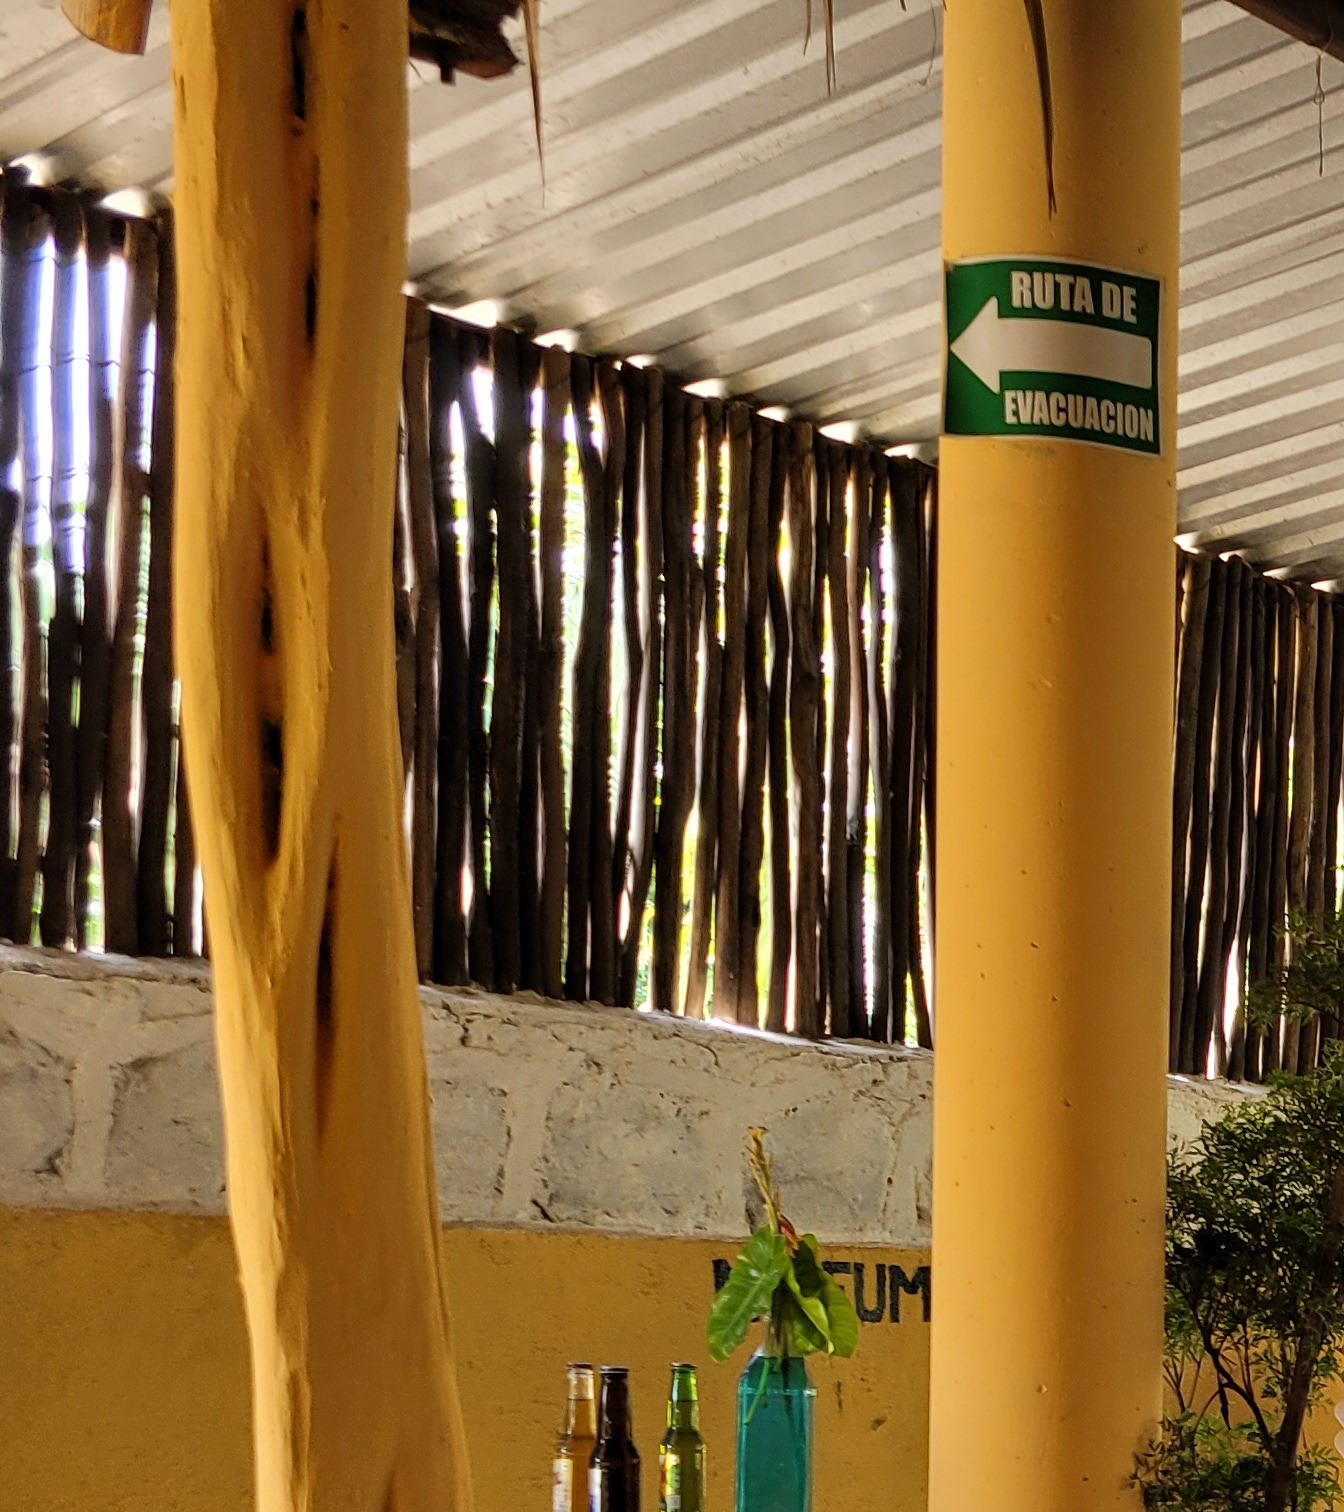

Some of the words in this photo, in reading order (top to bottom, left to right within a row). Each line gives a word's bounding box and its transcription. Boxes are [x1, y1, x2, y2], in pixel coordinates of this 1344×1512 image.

[1010, 271, 1095, 315] RUTA
[1101, 280, 1138, 324] DE
[1003, 390, 1154, 443] EVACUACION
